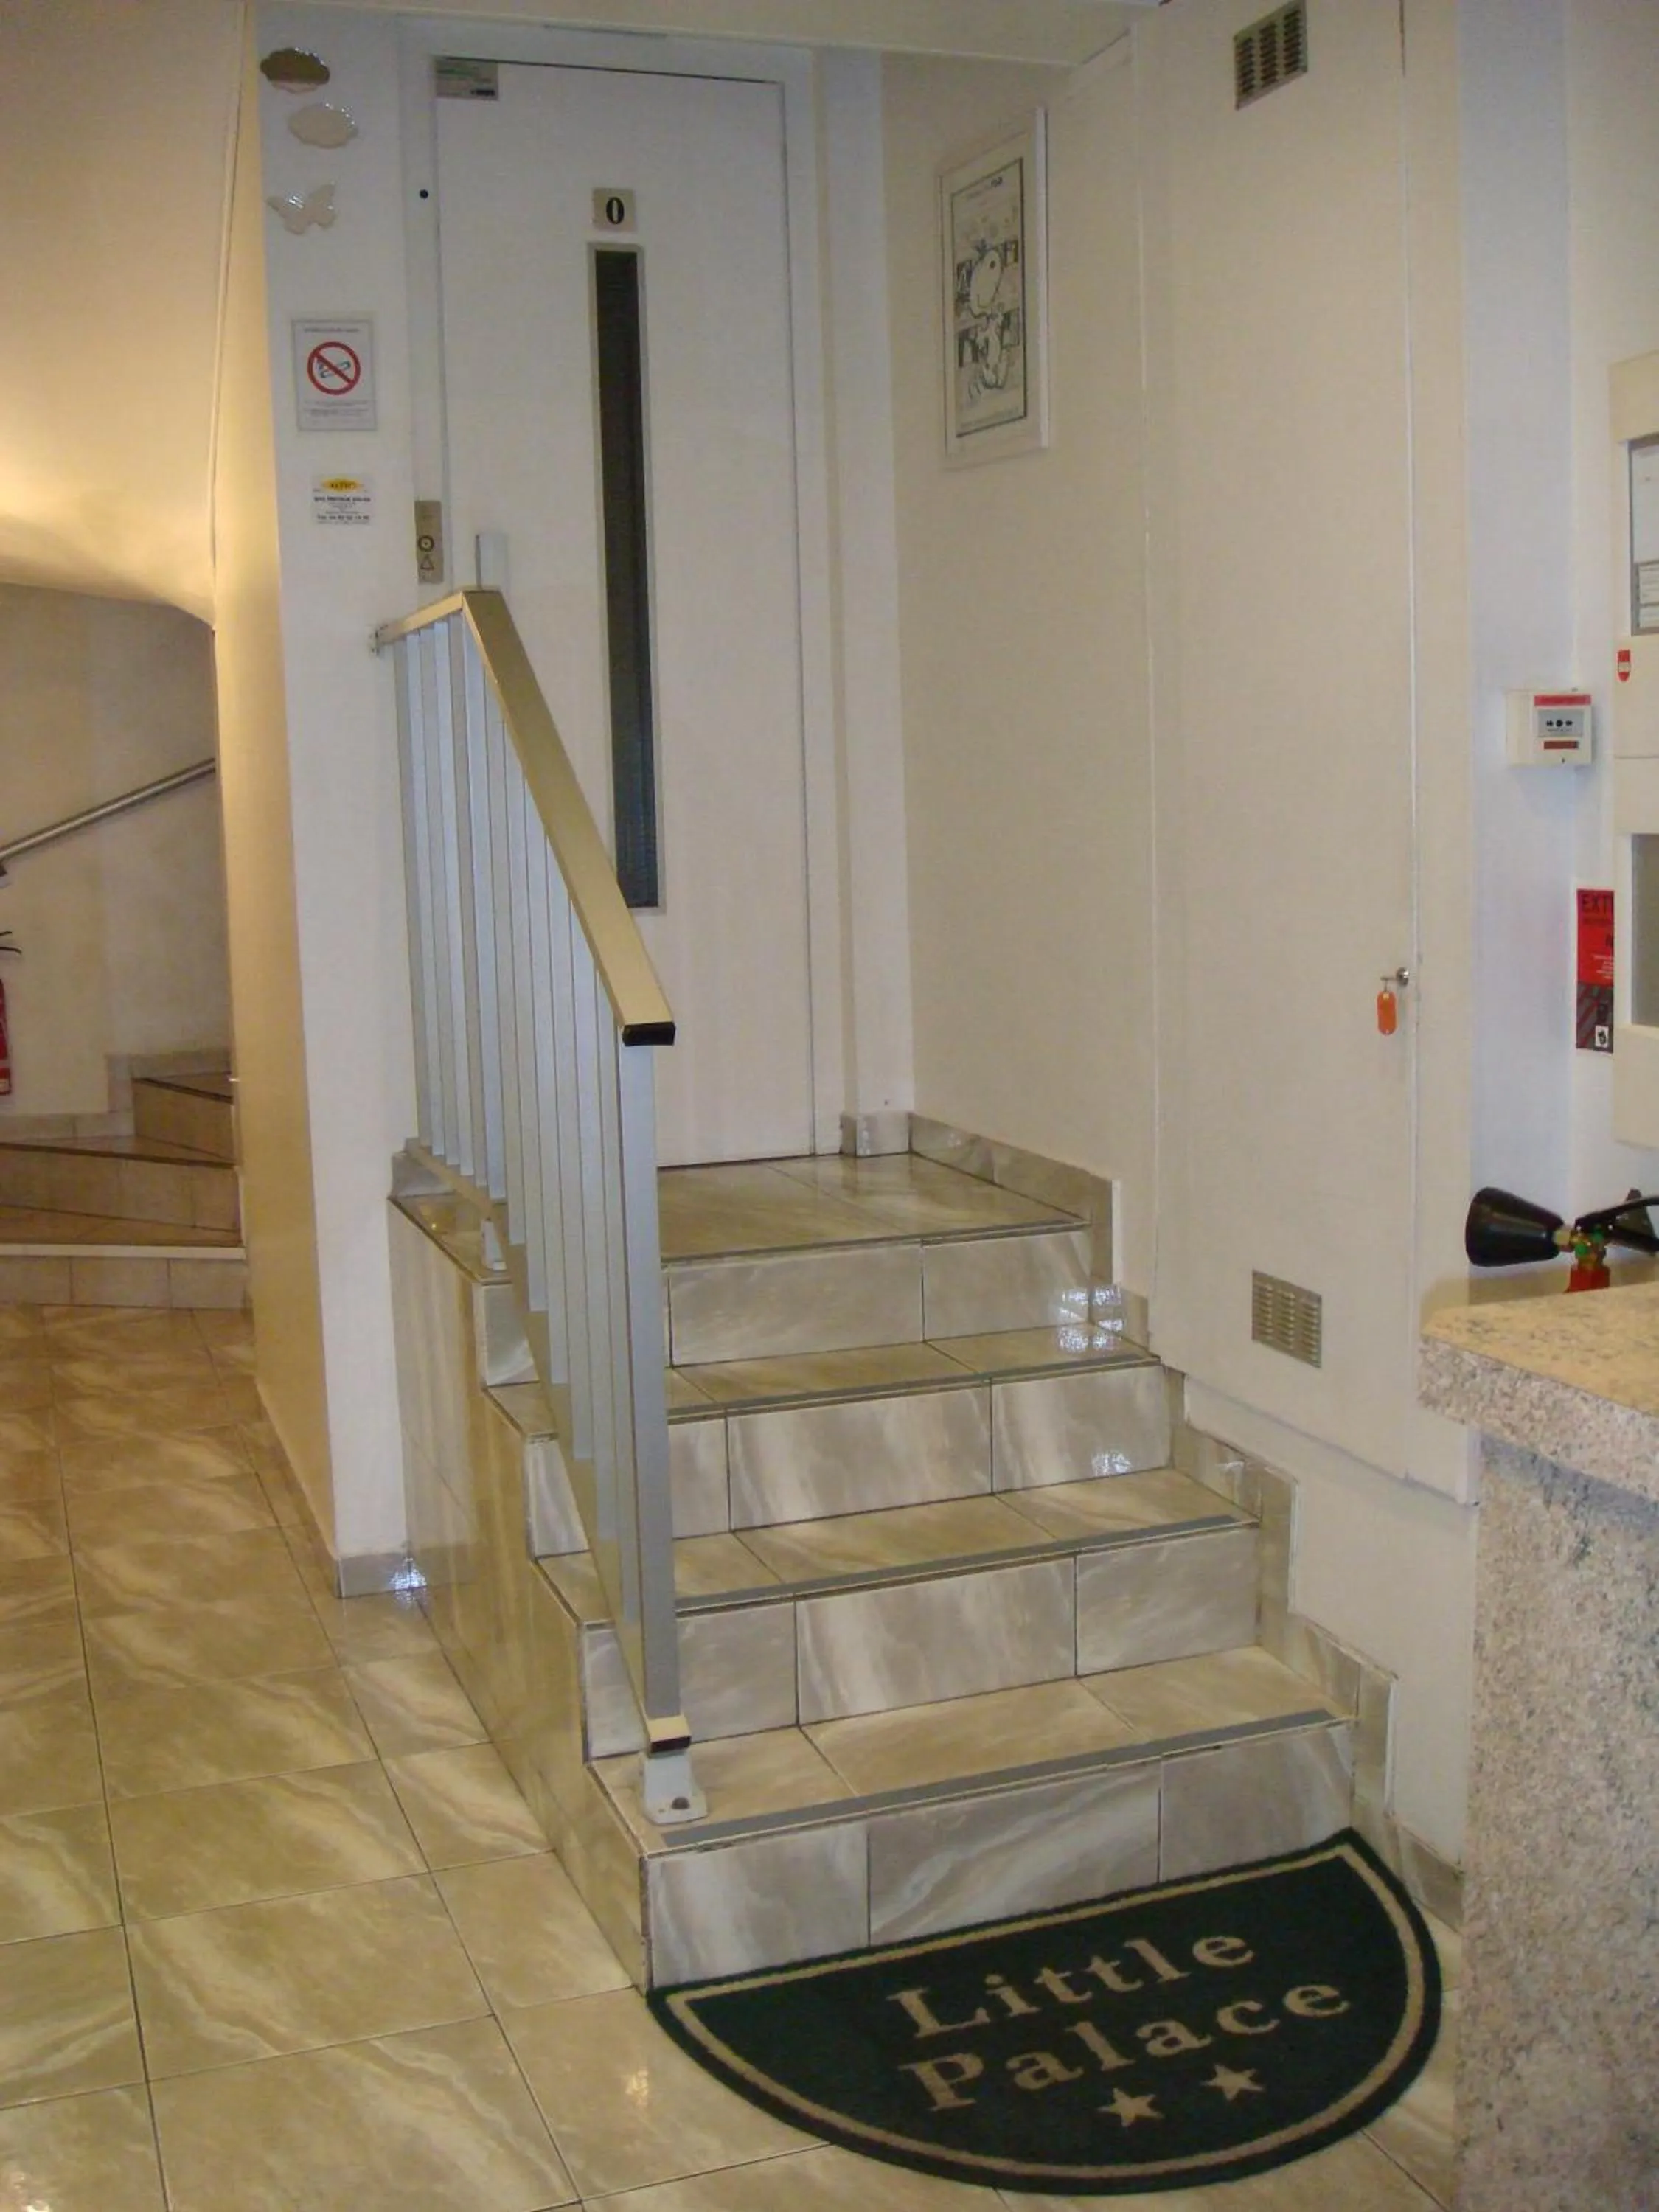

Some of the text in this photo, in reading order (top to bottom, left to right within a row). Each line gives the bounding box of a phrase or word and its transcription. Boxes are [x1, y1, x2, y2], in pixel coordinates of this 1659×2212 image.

[605, 196, 625, 226] 0
[886, 1935, 1254, 2039] Little
[897, 1983, 1351, 2112] Palace
